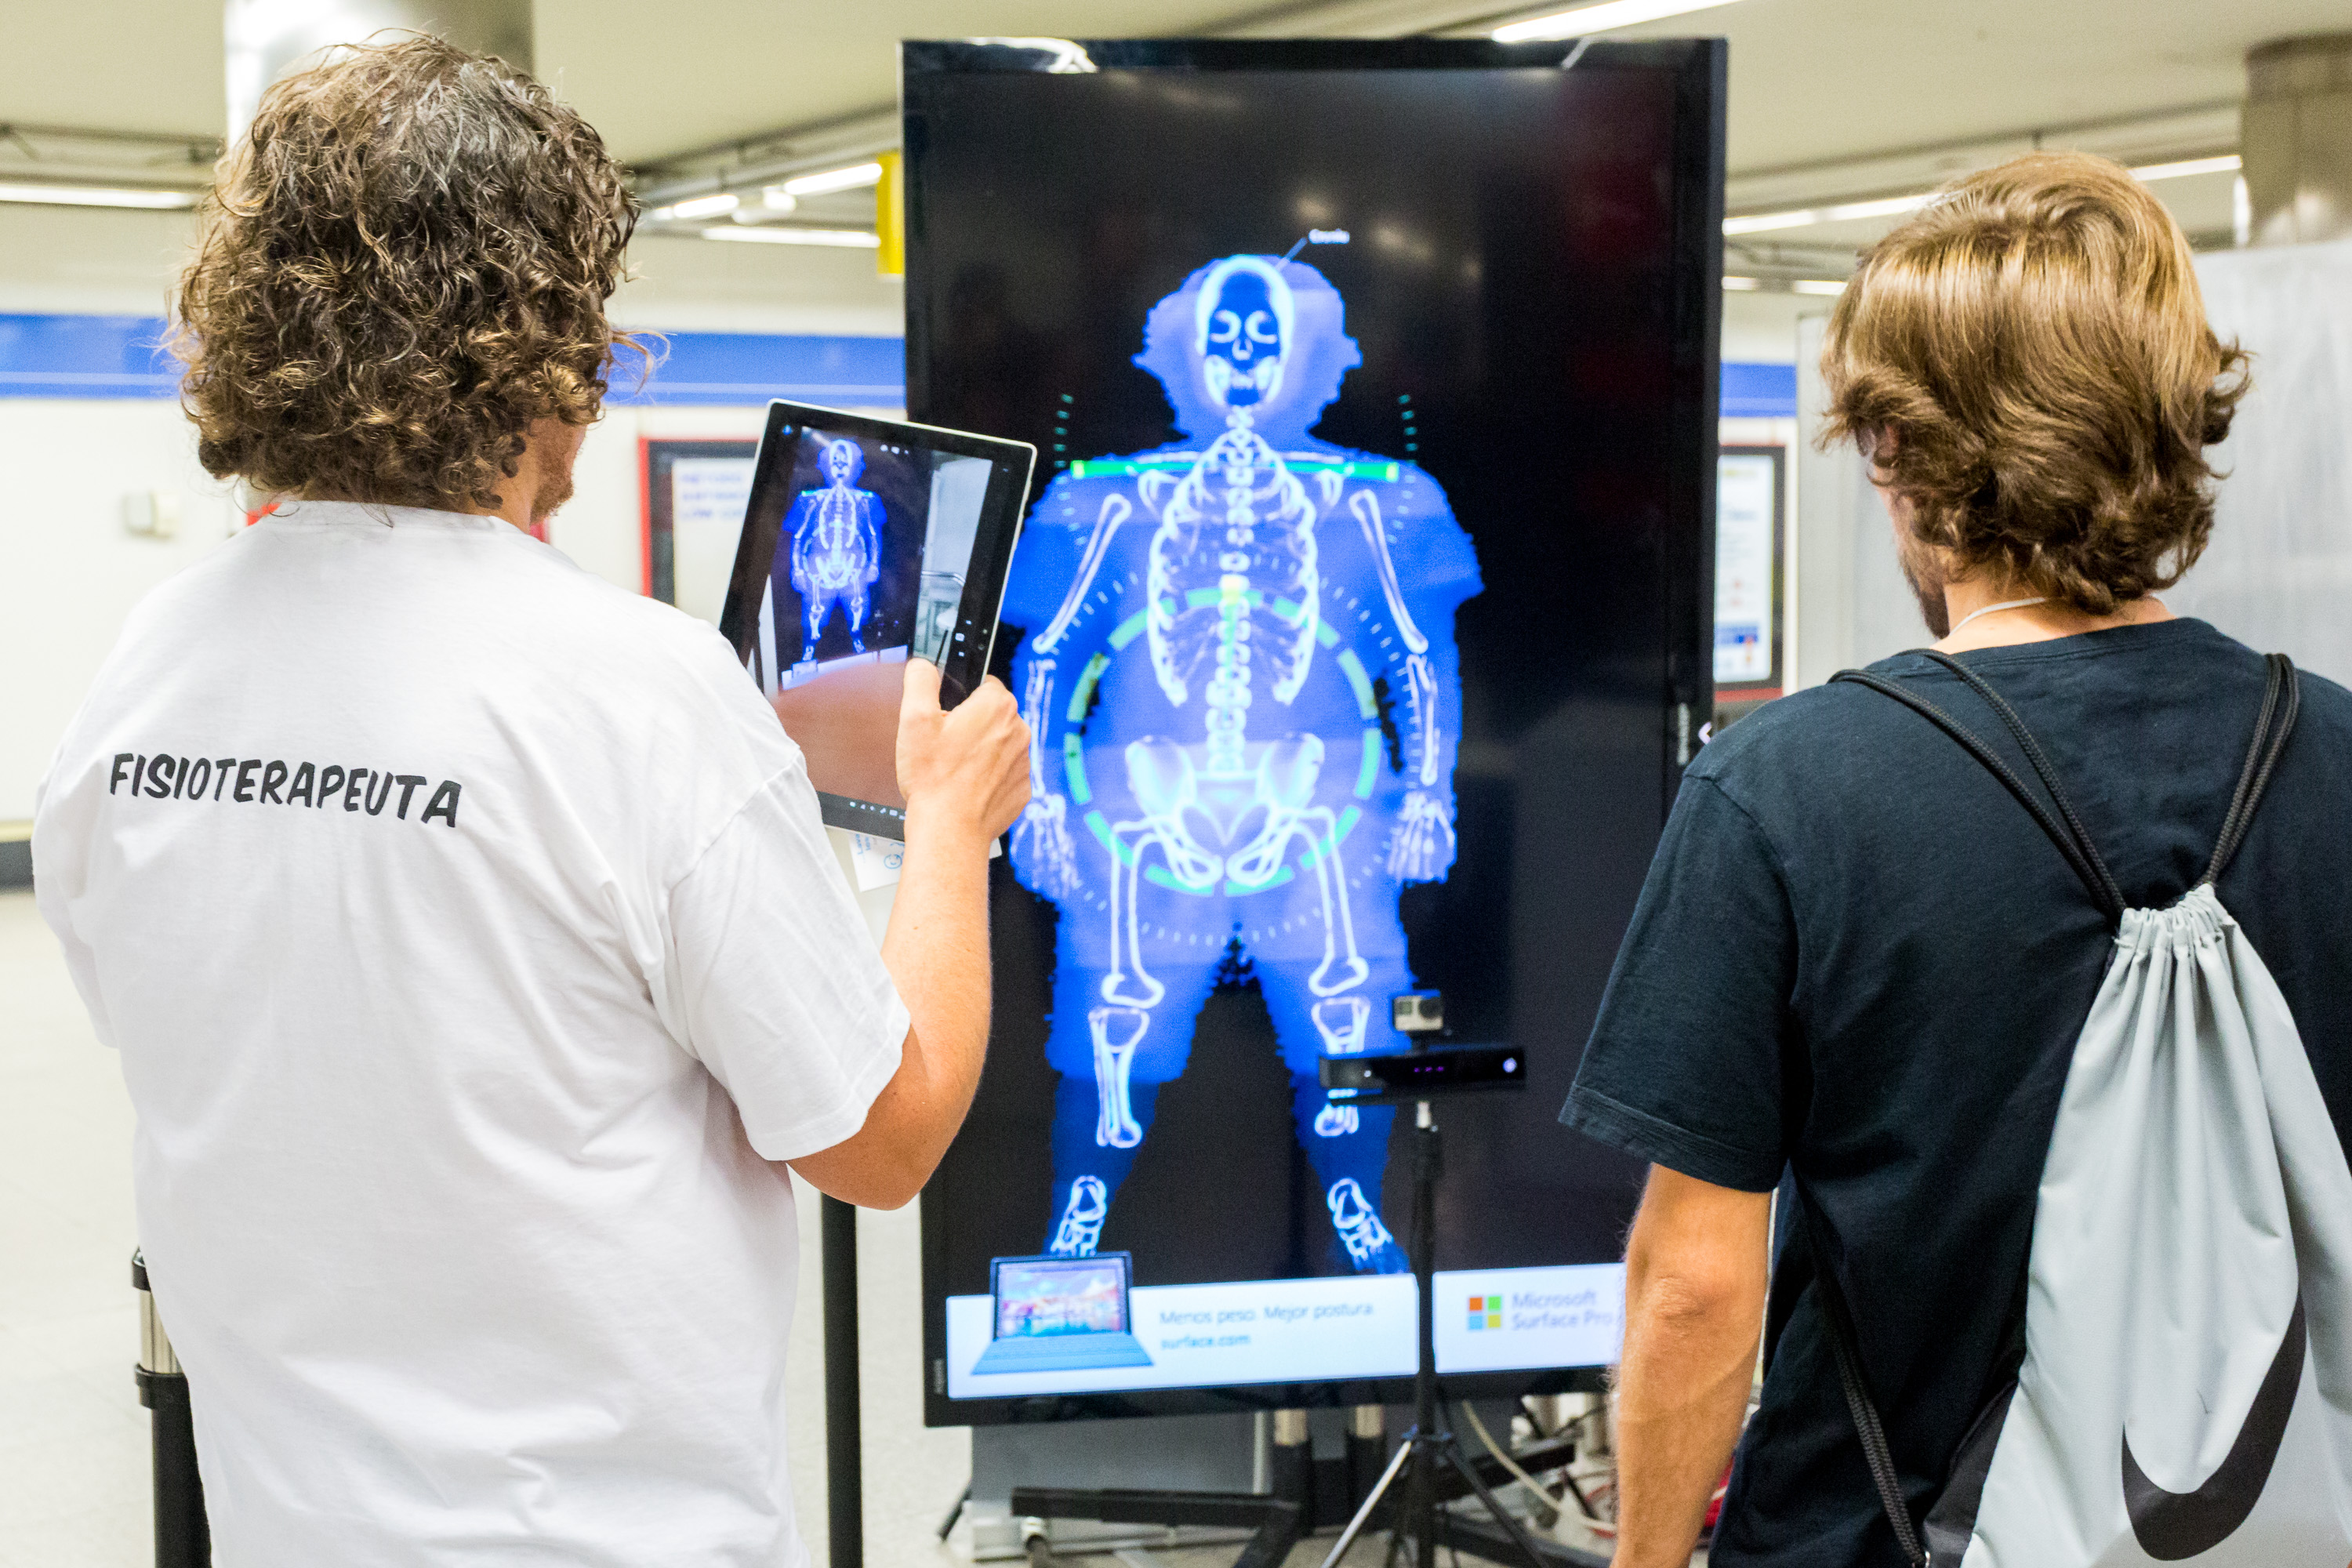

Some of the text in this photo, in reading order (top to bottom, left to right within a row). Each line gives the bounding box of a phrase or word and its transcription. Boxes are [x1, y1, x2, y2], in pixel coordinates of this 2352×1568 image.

[110, 753, 462, 828] FISIOTERAPEUTA
[1512, 1288, 1596, 1308] Microsoft
[1160, 1311, 1212, 1324] Menos
[1264, 1305, 1308, 1323] Mejor
[1313, 1303, 1373, 1320] postura
[1512, 1310, 1578, 1330] Surface
[1160, 1334, 1251, 1350] surface.com
